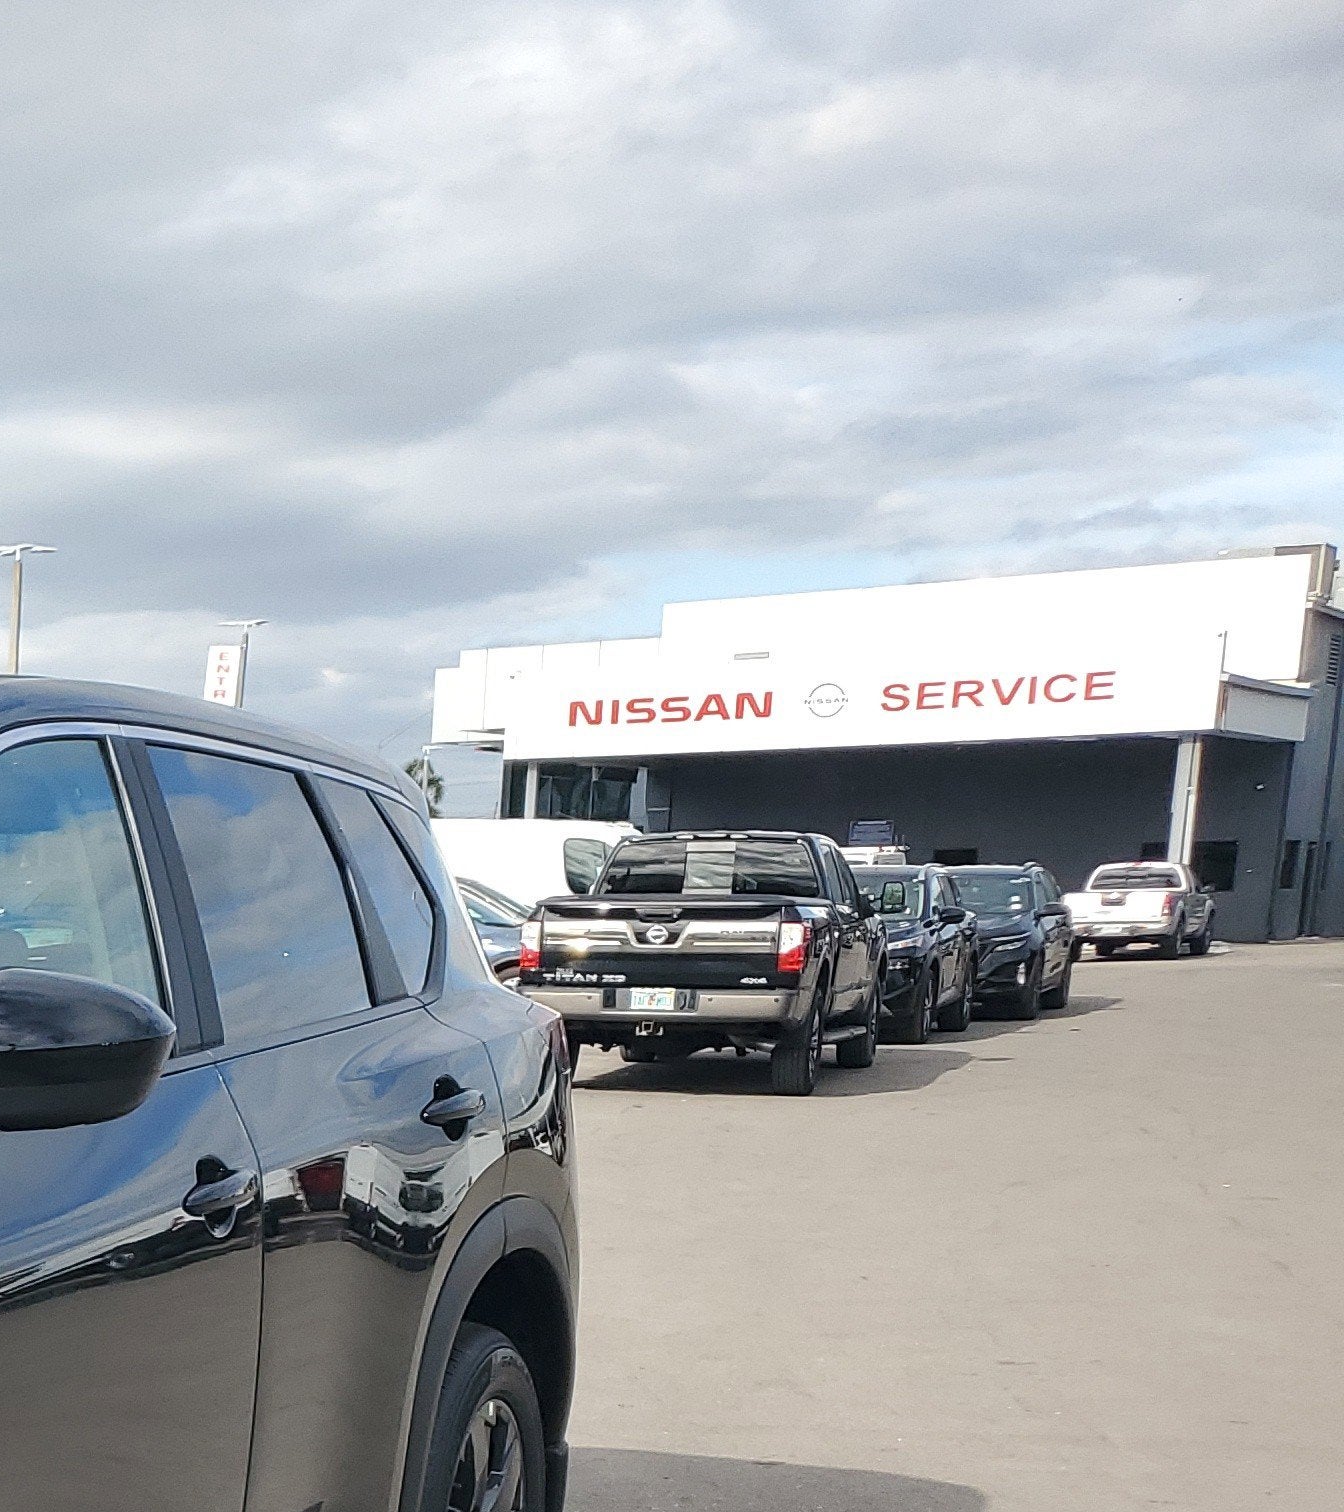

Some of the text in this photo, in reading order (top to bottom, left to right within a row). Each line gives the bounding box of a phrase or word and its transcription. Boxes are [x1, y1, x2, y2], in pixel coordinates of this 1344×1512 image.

[568, 671, 1116, 727] NISSAN SERVICE
[803, 697, 849, 705] NISSAN
[542, 972, 598, 983] TITAN
